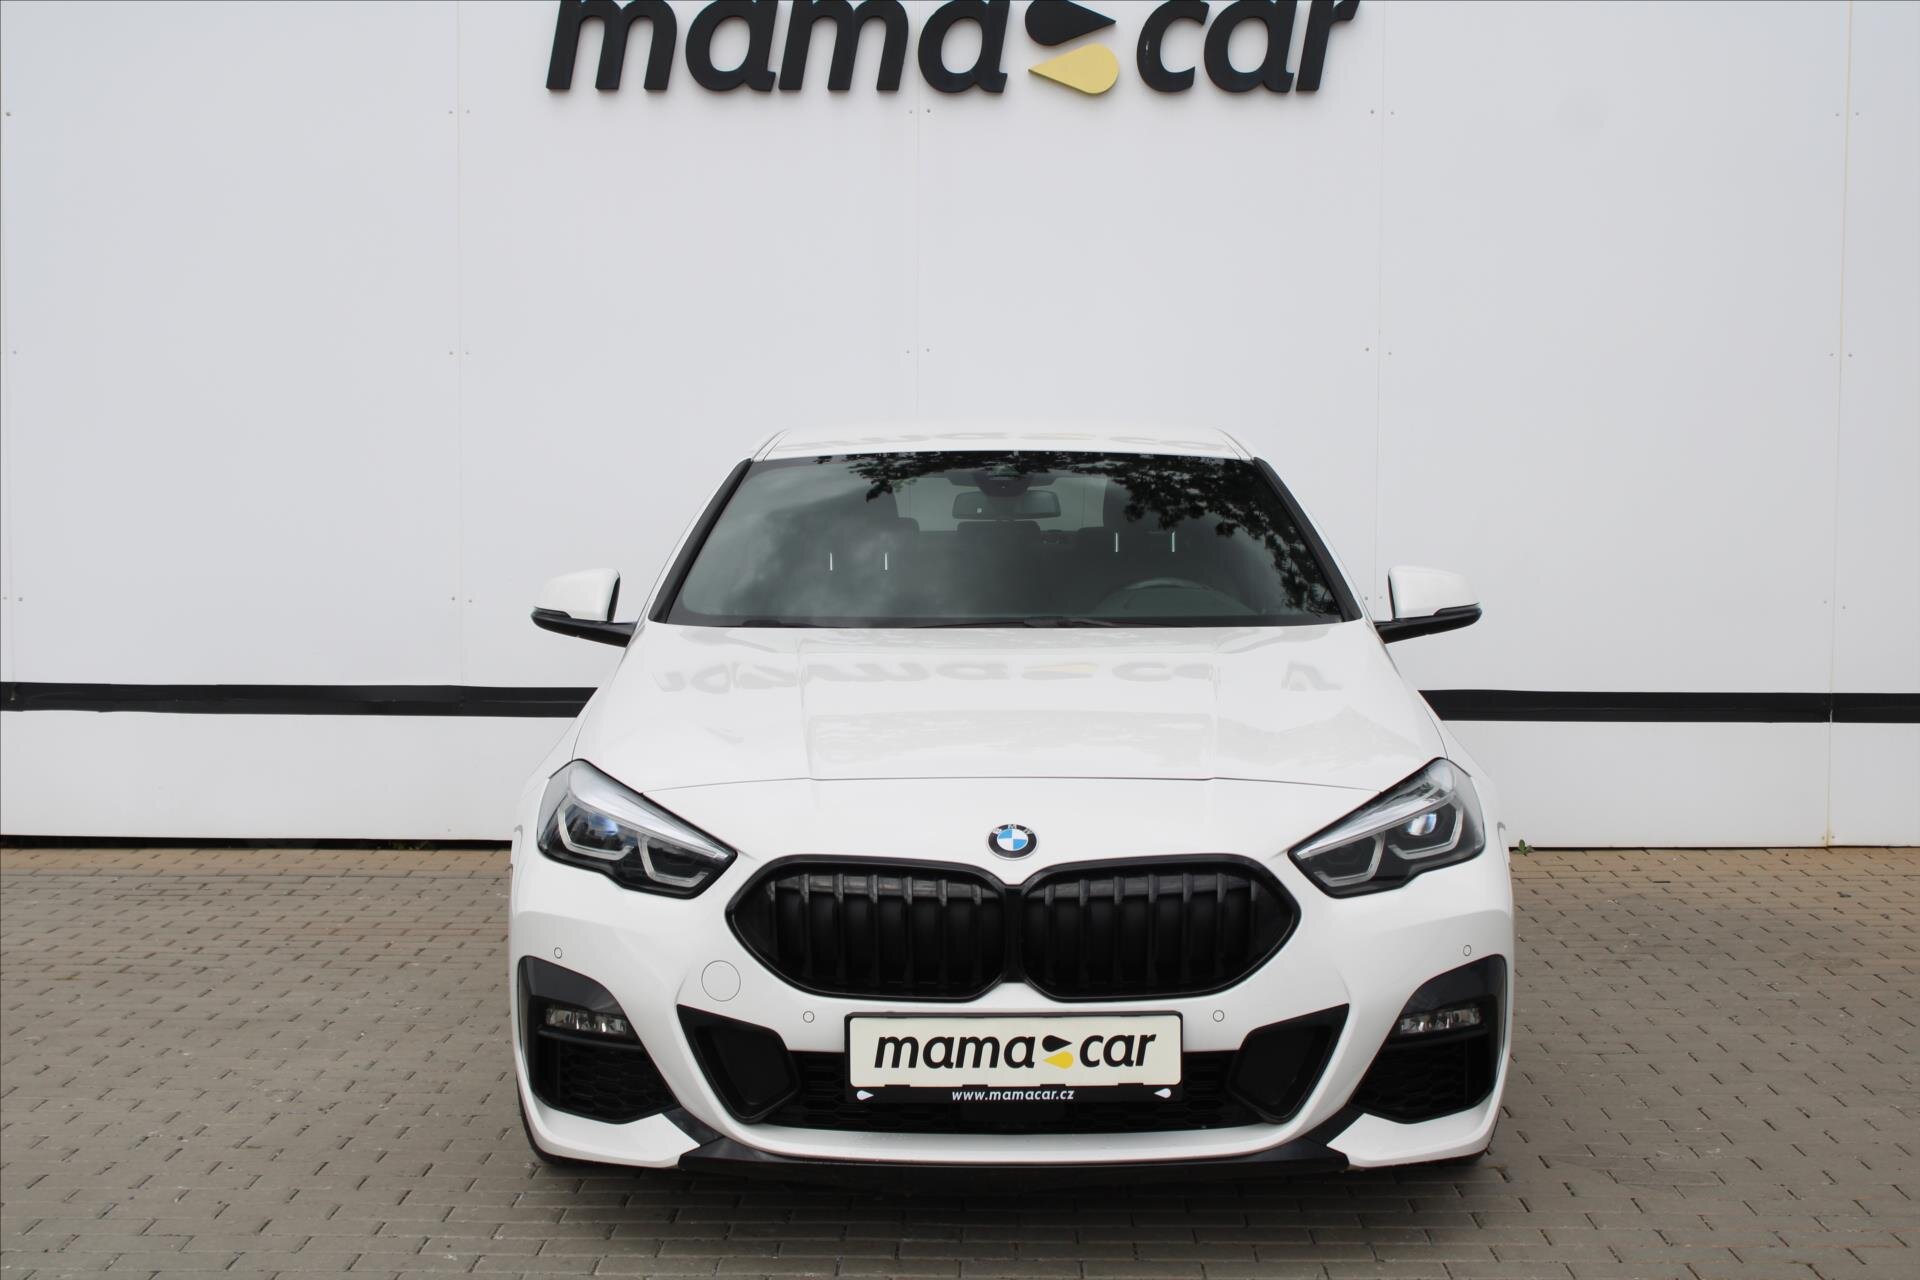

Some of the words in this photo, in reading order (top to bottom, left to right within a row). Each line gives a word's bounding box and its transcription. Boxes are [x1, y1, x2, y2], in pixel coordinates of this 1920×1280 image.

[546, 0, 1010, 94] mama
[1136, 0, 1361, 94] car
[874, 1034, 1036, 1069] mama
[1079, 1033, 1157, 1068] car
[951, 1088, 1075, 1102] www.mamacar.cz
